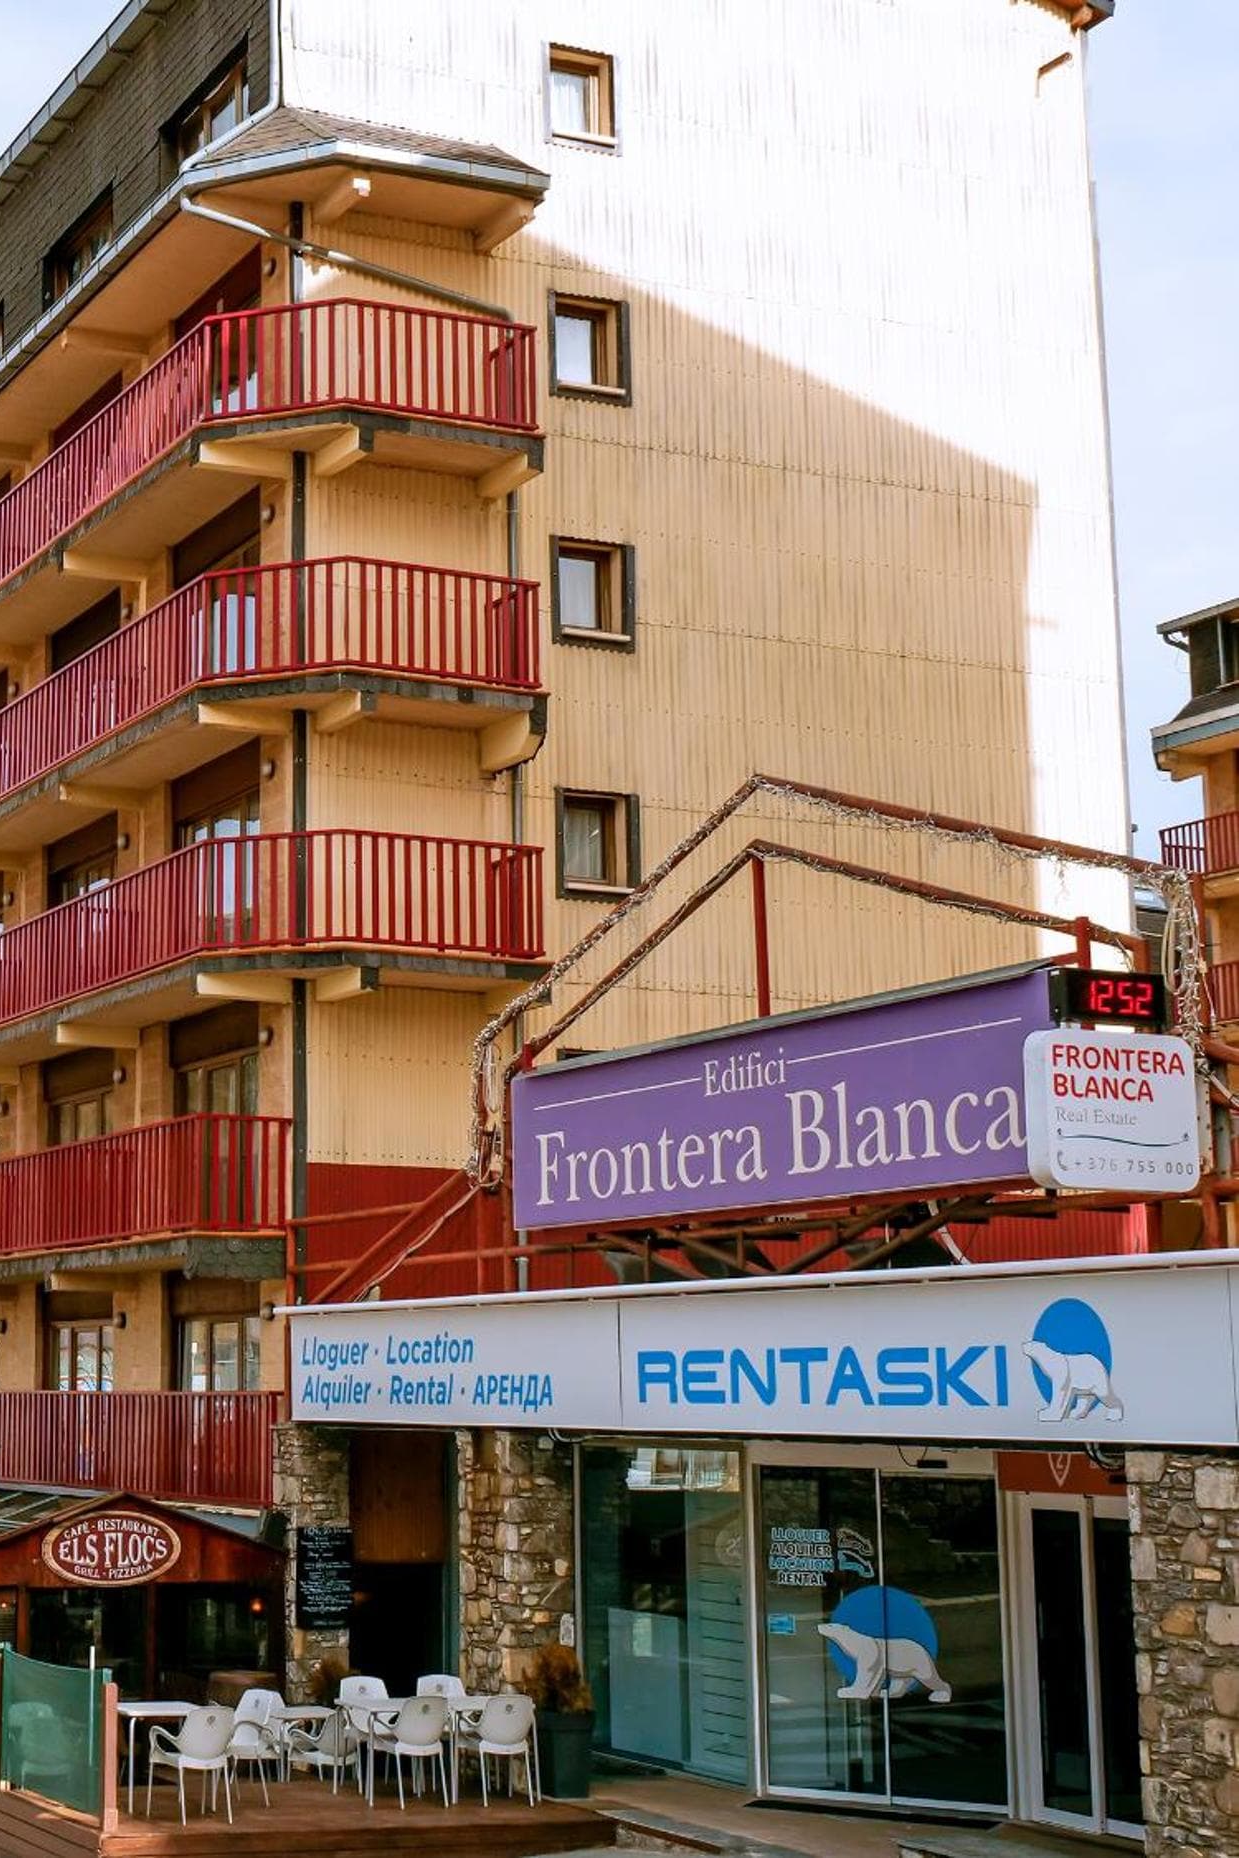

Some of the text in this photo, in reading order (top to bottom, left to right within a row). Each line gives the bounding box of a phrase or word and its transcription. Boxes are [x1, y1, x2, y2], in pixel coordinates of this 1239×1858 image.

[704, 1047, 787, 1097] Edifici
[1052, 1044, 1185, 1076] FRONTERA
[1053, 1073, 1154, 1102] BLANCA
[1055, 1106, 1137, 1126] Real Estate
[535, 1081, 1027, 1206] Frontera Blanca
[1127, 1160, 1156, 1173] 755
[1165, 1162, 1194, 1175] 000
[301, 1332, 474, 1370] Lloguer Location
[637, 1345, 1009, 1407] RENTASKI
[301, 1373, 554, 1413] Alquiler Rental АРЕНДА
[97, 1518, 159, 1537] RESTAURANT
[771, 1527, 831, 1543] LLOGUER
[59, 1532, 168, 1568] ELS FLOCS
[770, 1542, 832, 1558] ALQUILER
[108, 1563, 153, 1579] PIZZERIA
[769, 1556, 835, 1573] LOCATION
[778, 1571, 827, 1586] RENTAL
